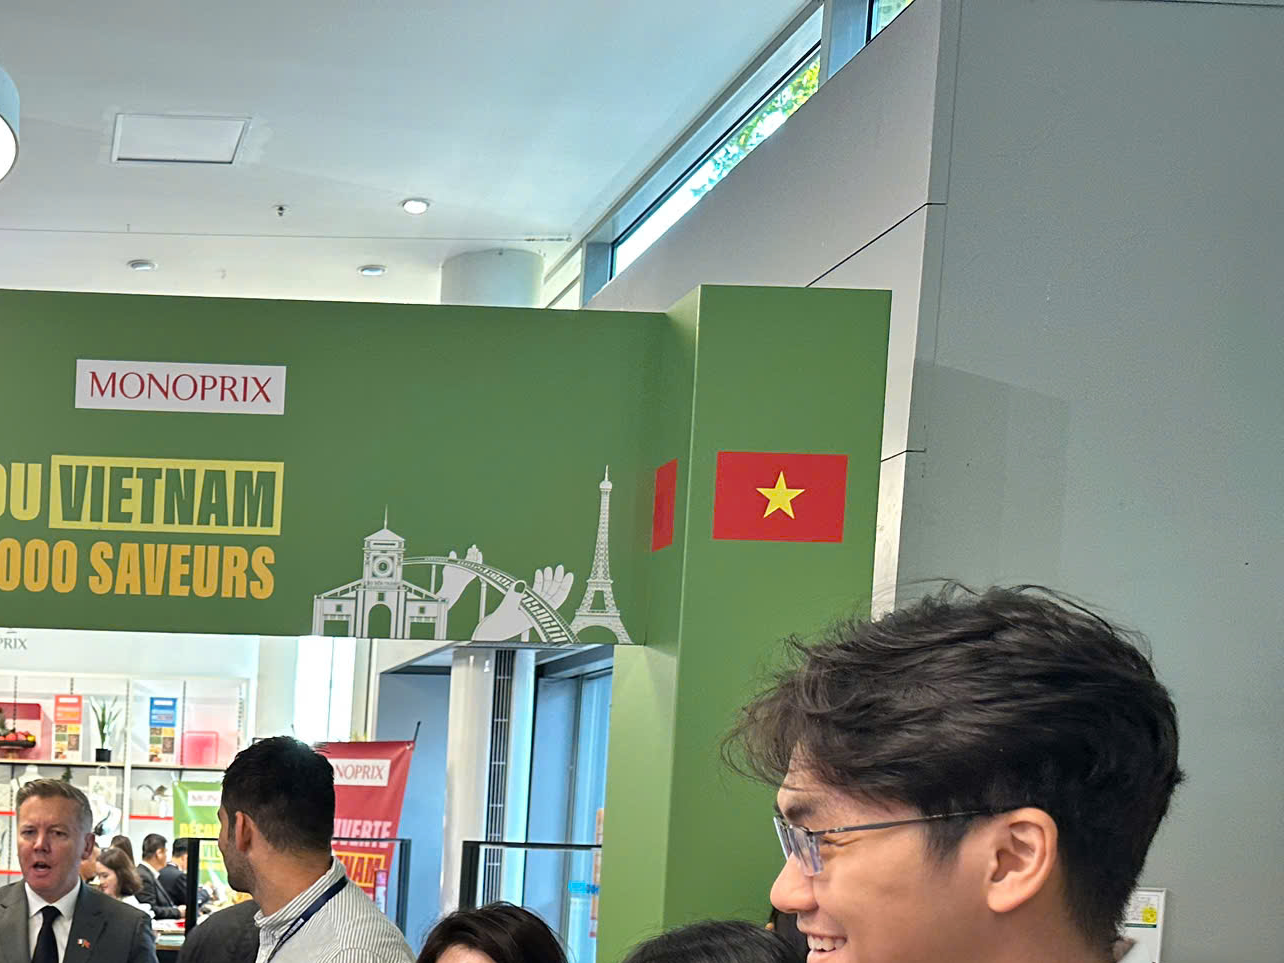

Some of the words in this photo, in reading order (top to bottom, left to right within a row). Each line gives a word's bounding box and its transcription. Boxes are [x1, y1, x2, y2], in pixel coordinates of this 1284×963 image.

[88, 370, 272, 404] MONOPRIX
[58, 464, 276, 529] VIETNAM
[88, 541, 275, 599] SAVEURS
[335, 764, 384, 780] NOPRIX
